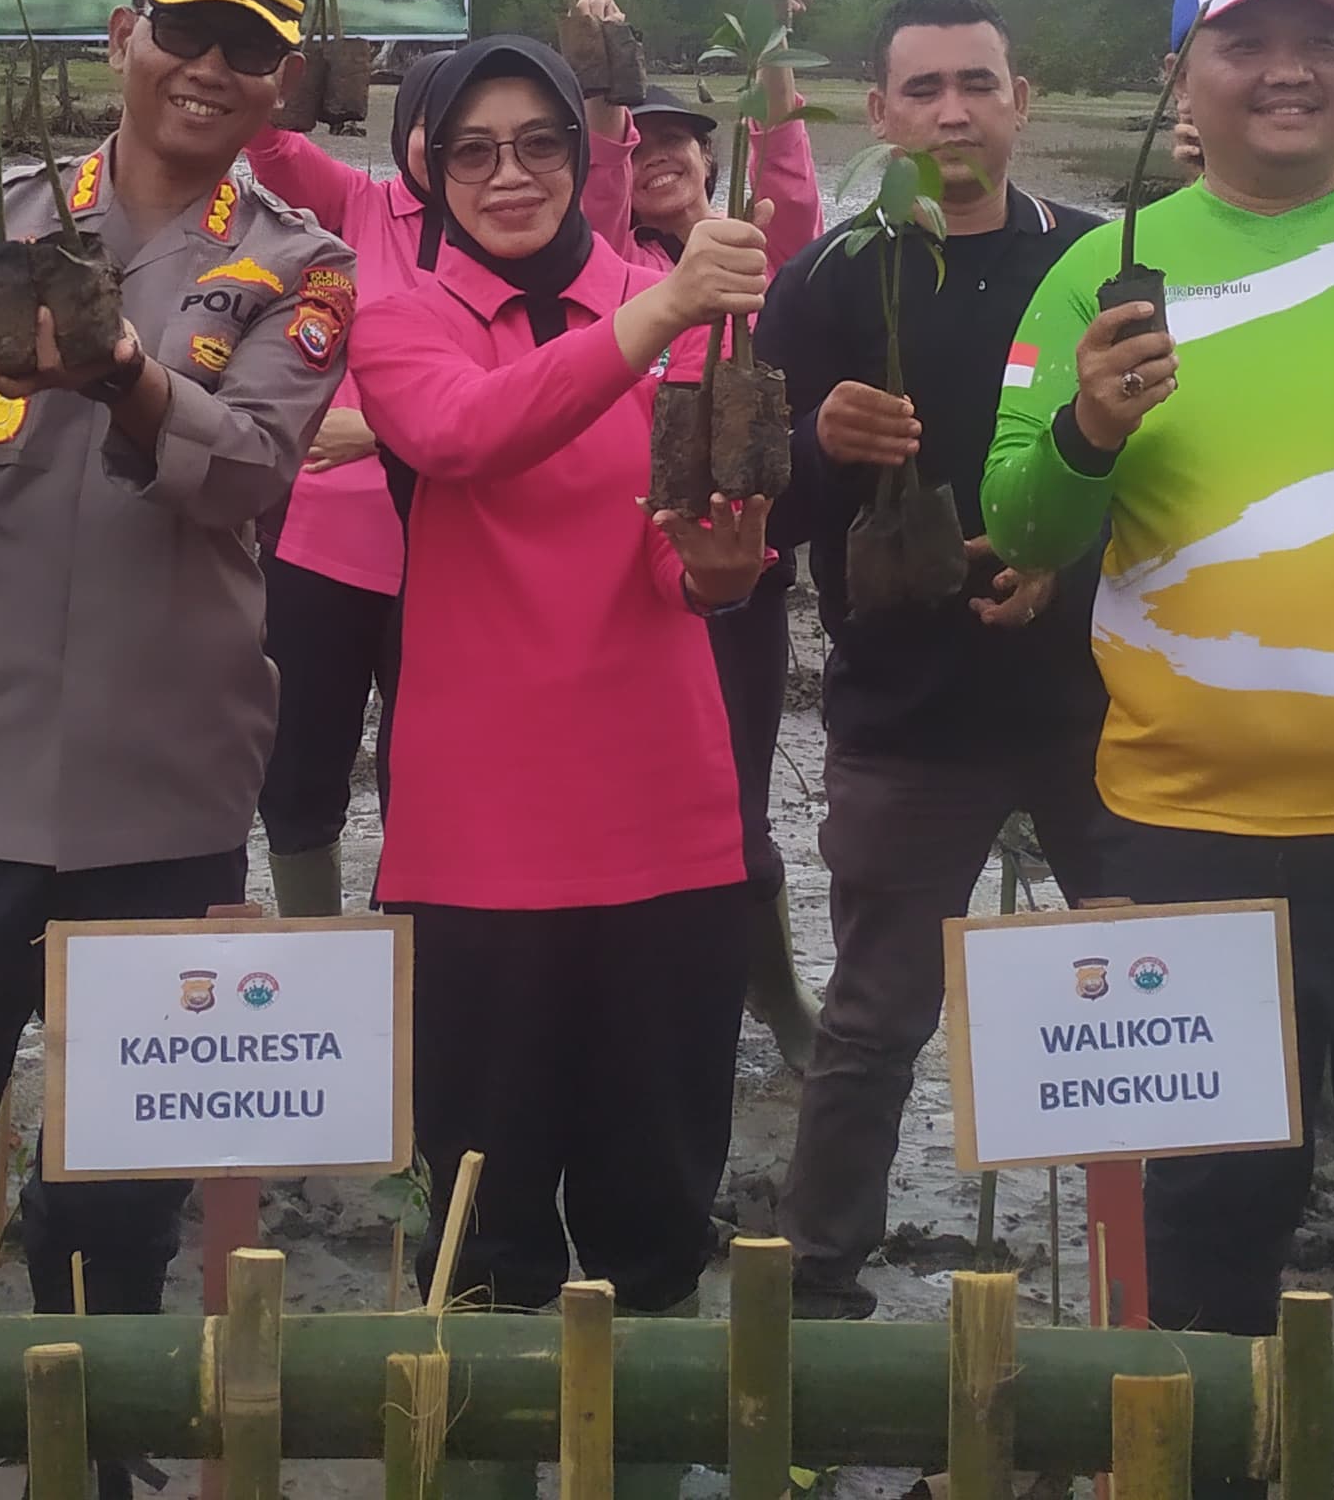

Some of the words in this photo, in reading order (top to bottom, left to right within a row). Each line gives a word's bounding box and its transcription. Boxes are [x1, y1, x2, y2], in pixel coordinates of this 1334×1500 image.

[1187, 281, 1251, 299] bengkulu
[120, 1031, 343, 1066] KAPOLRESTA
[1039, 1014, 1215, 1054] WALIKOTA
[135, 1089, 325, 1122] BENGKULU
[1039, 1070, 1220, 1111] BENGKULU
